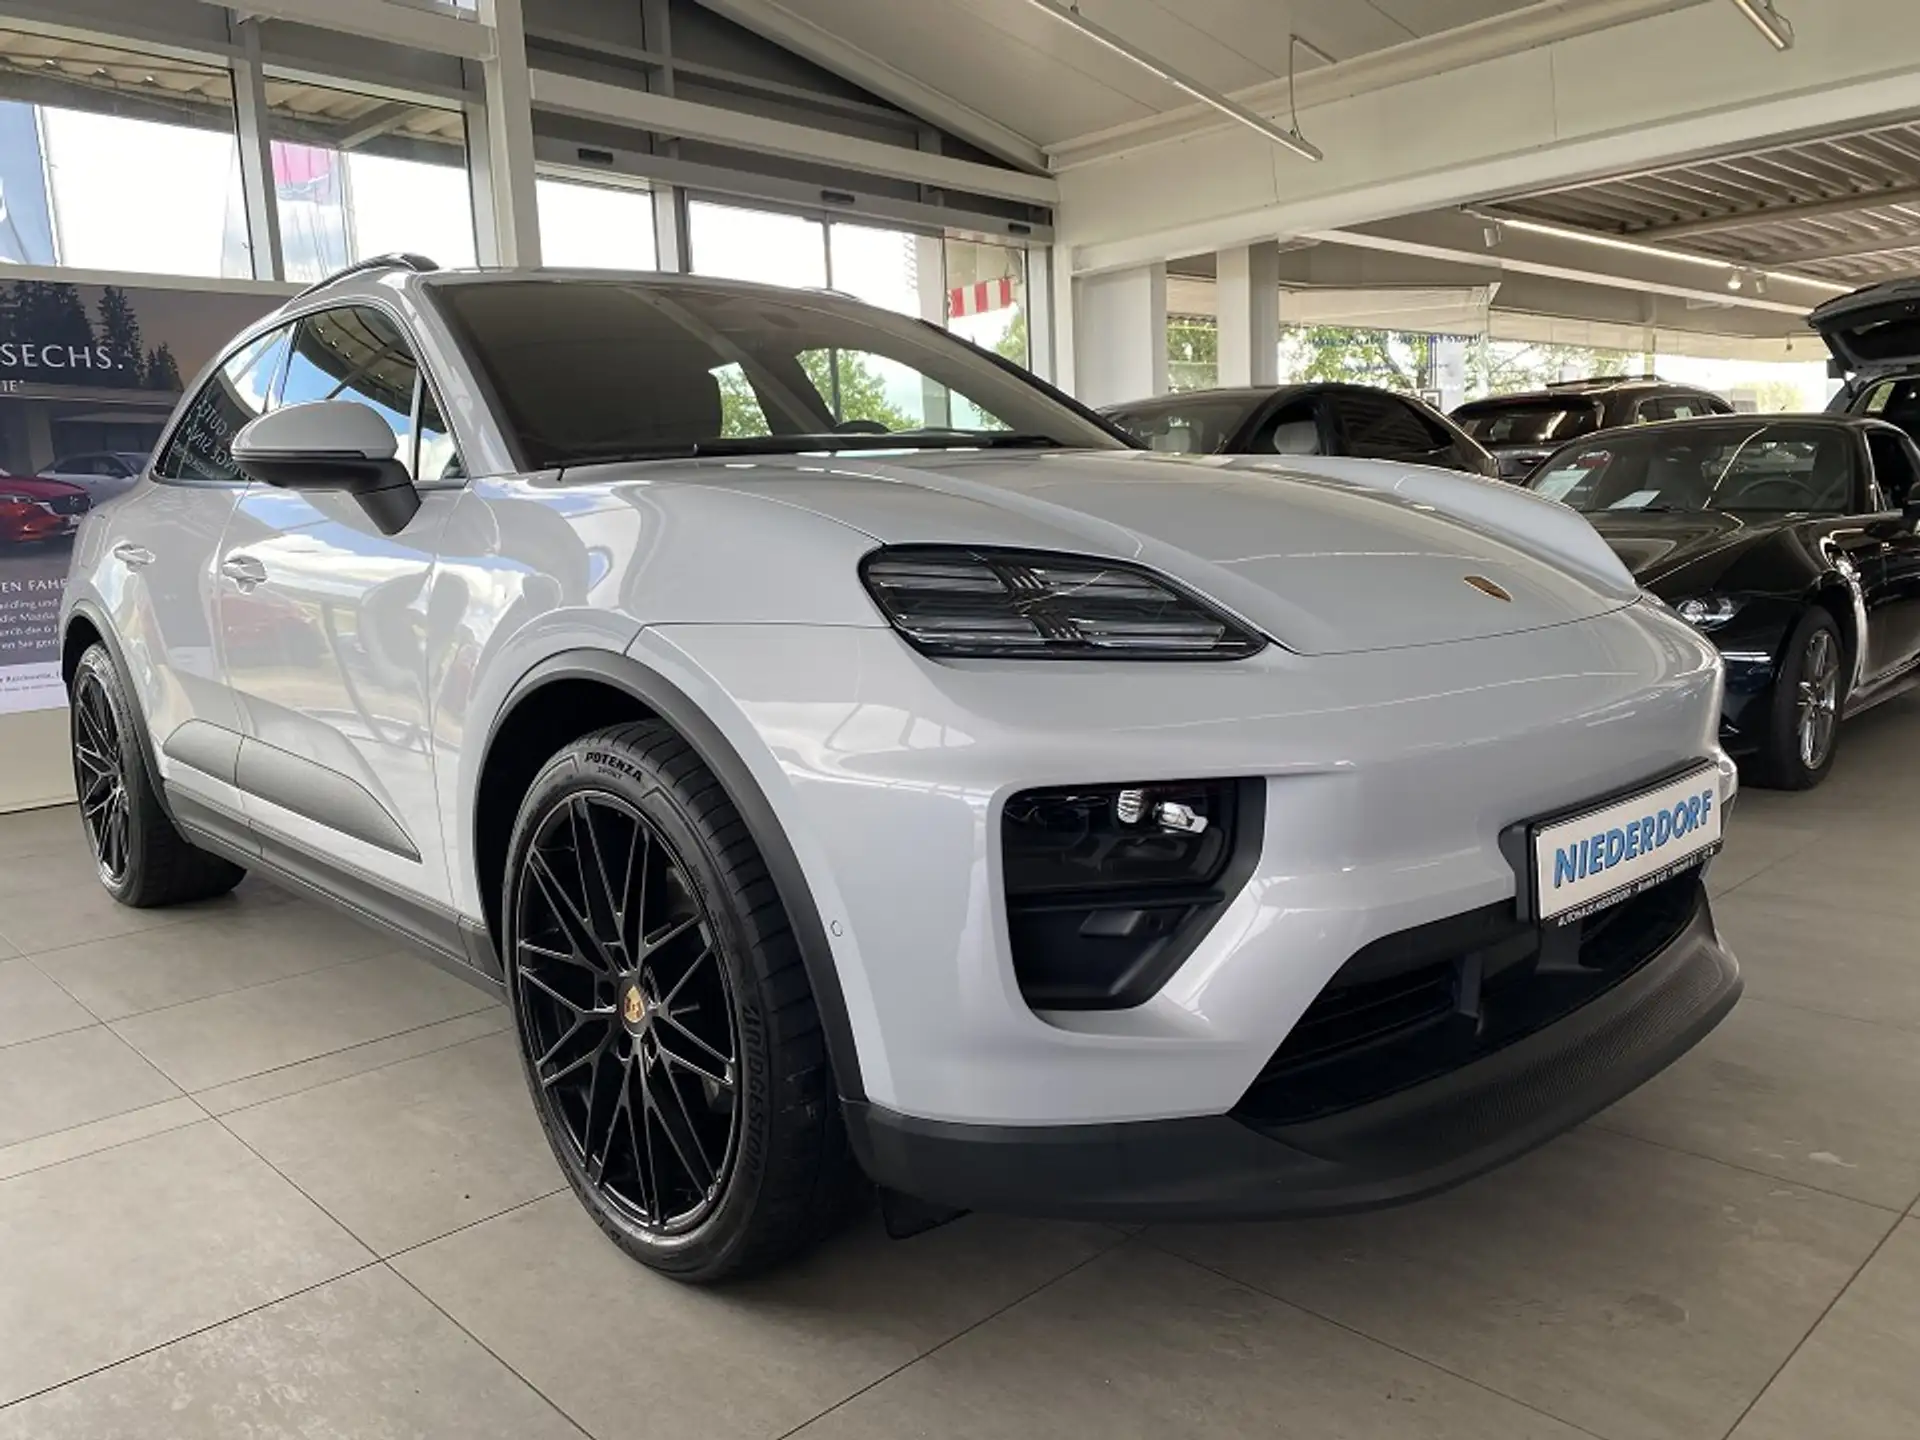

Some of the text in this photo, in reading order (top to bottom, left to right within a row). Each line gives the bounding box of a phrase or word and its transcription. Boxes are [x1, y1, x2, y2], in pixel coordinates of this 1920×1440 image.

[0, 342, 124, 369] SECHS.
[584, 751, 642, 783] POTENZA
[1553, 788, 1713, 889] NIEDERDORF
